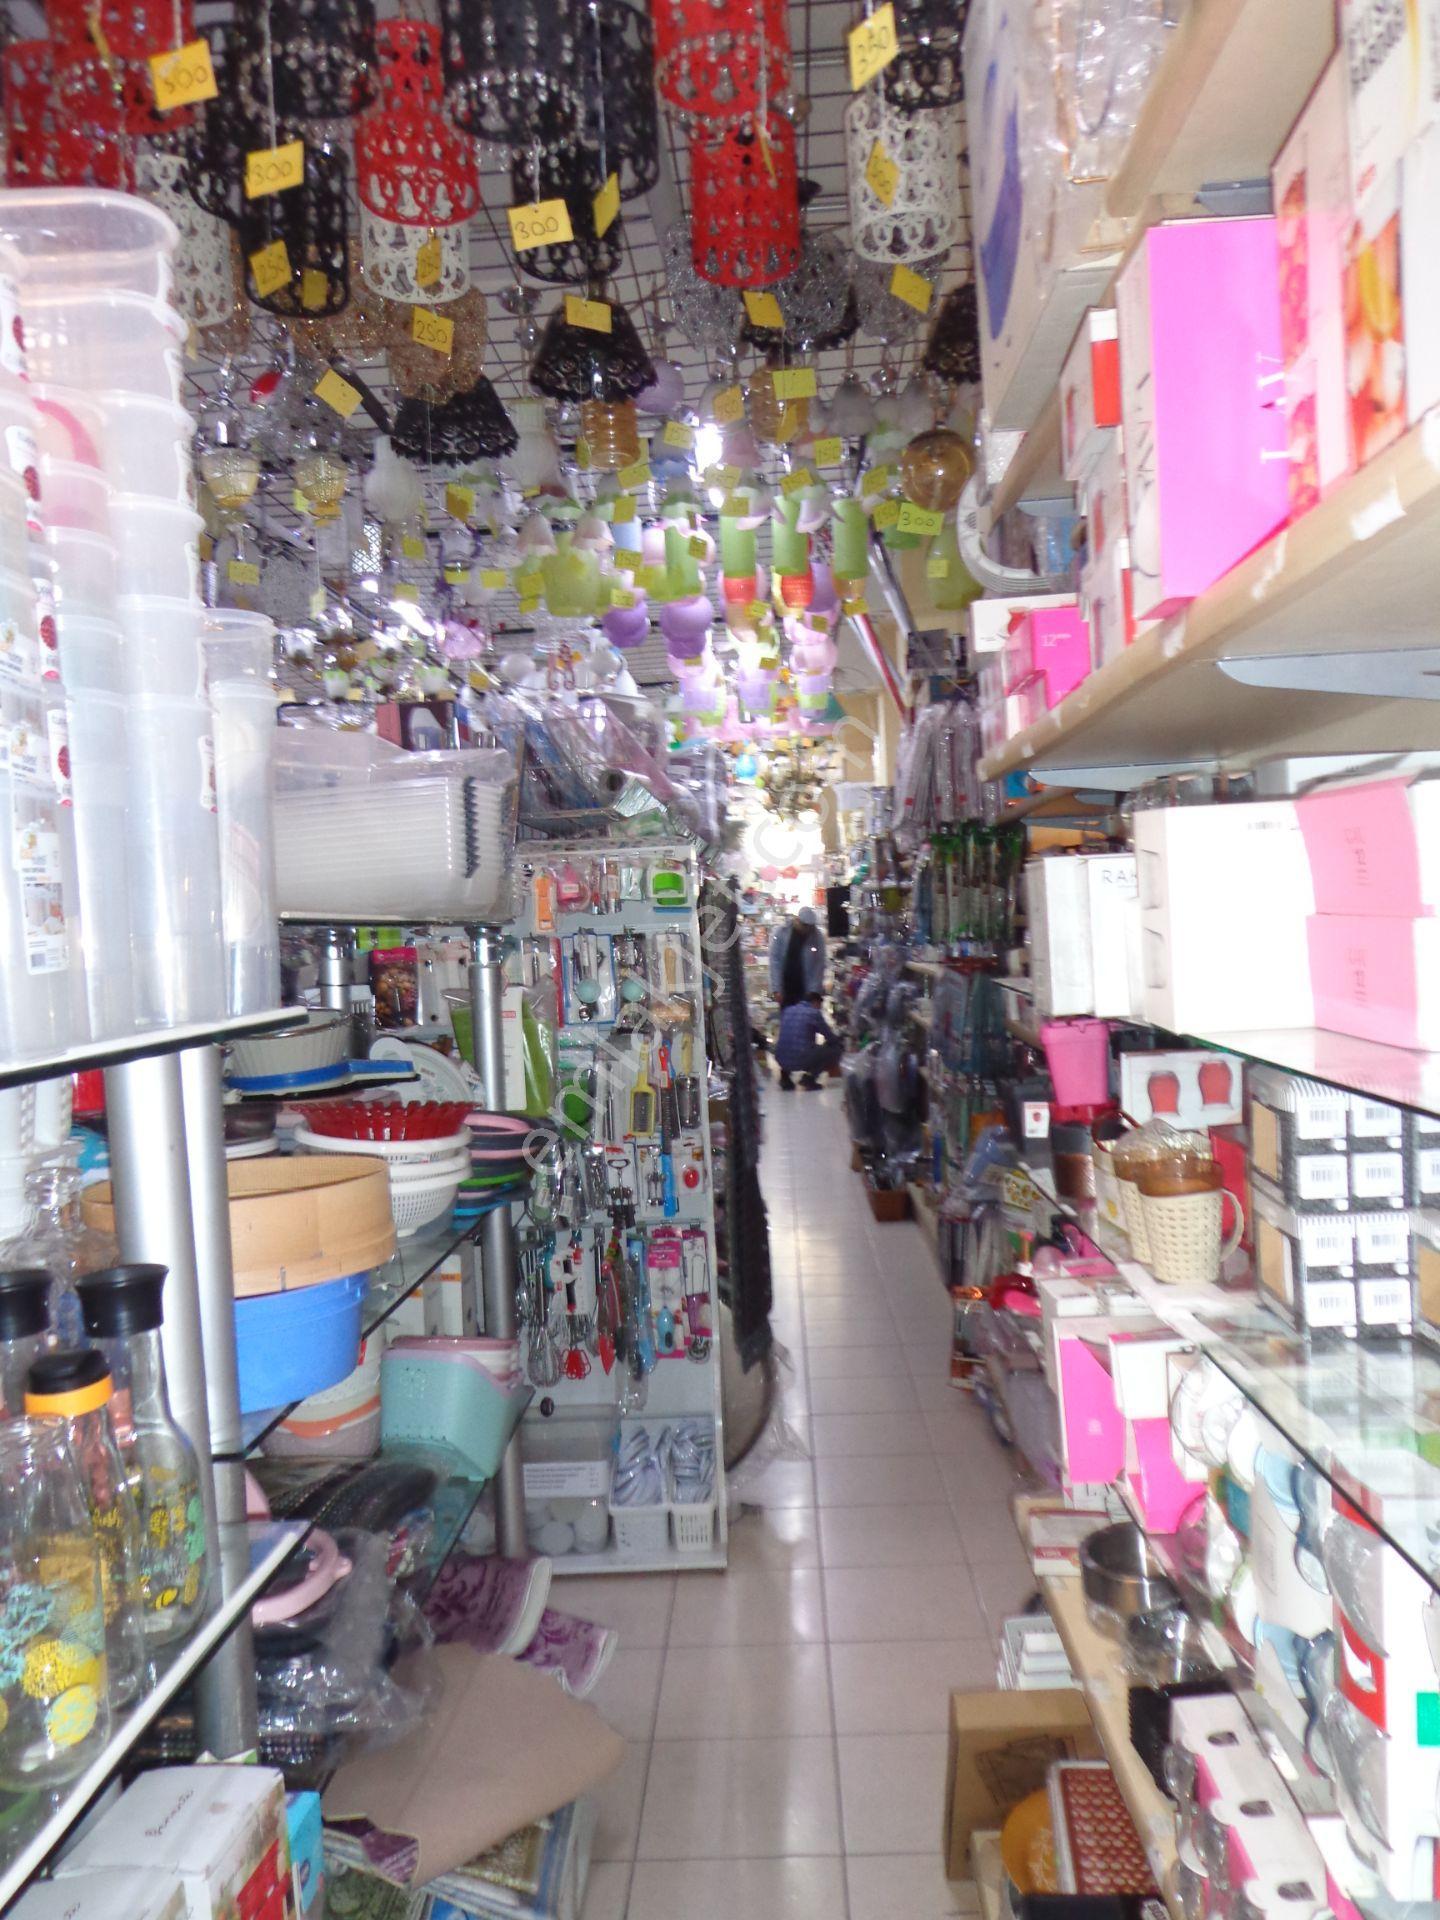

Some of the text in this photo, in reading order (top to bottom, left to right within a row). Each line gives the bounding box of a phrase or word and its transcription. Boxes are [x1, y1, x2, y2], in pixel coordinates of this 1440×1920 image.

[515, 216, 559, 240] 300
[417, 319, 448, 346] 250
[900, 510, 935, 528] 300
